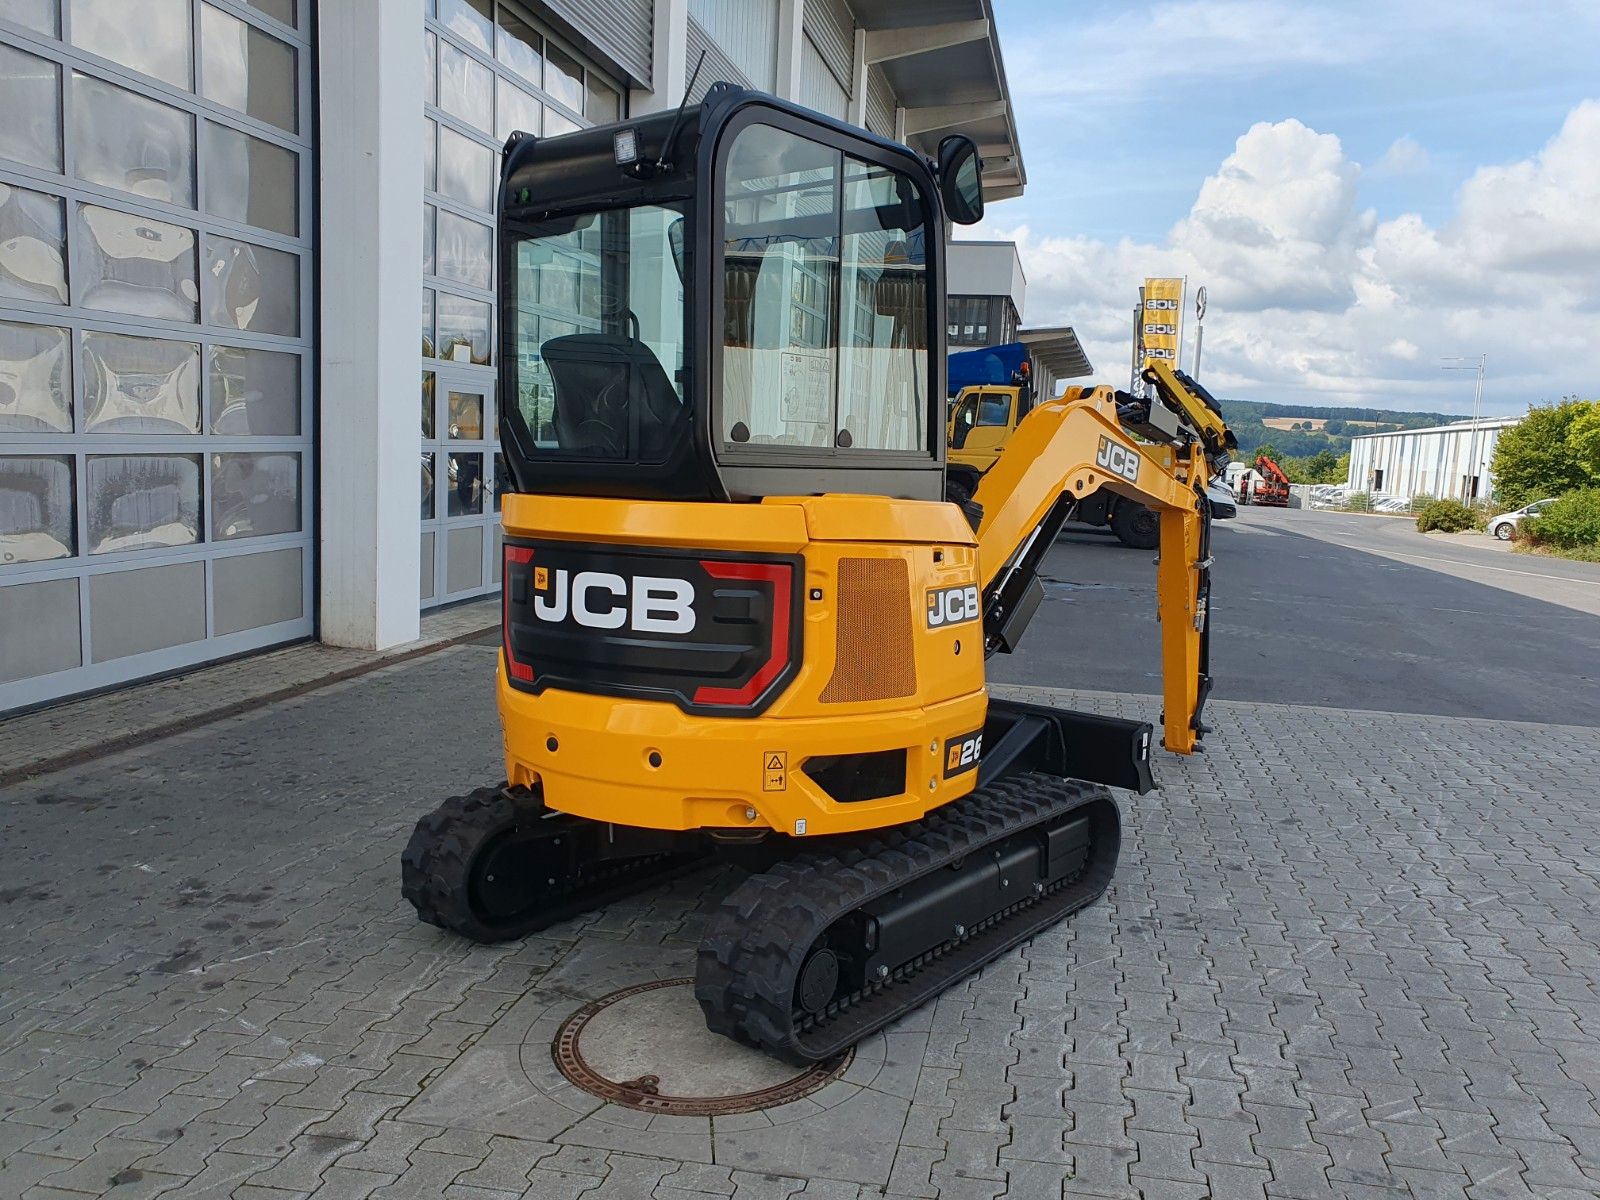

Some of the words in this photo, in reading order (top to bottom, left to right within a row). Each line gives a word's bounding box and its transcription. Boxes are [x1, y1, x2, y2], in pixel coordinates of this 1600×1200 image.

[1098, 442, 1138, 480] JCB
[534, 569, 697, 634] JCB
[928, 587, 978, 625] JCB
